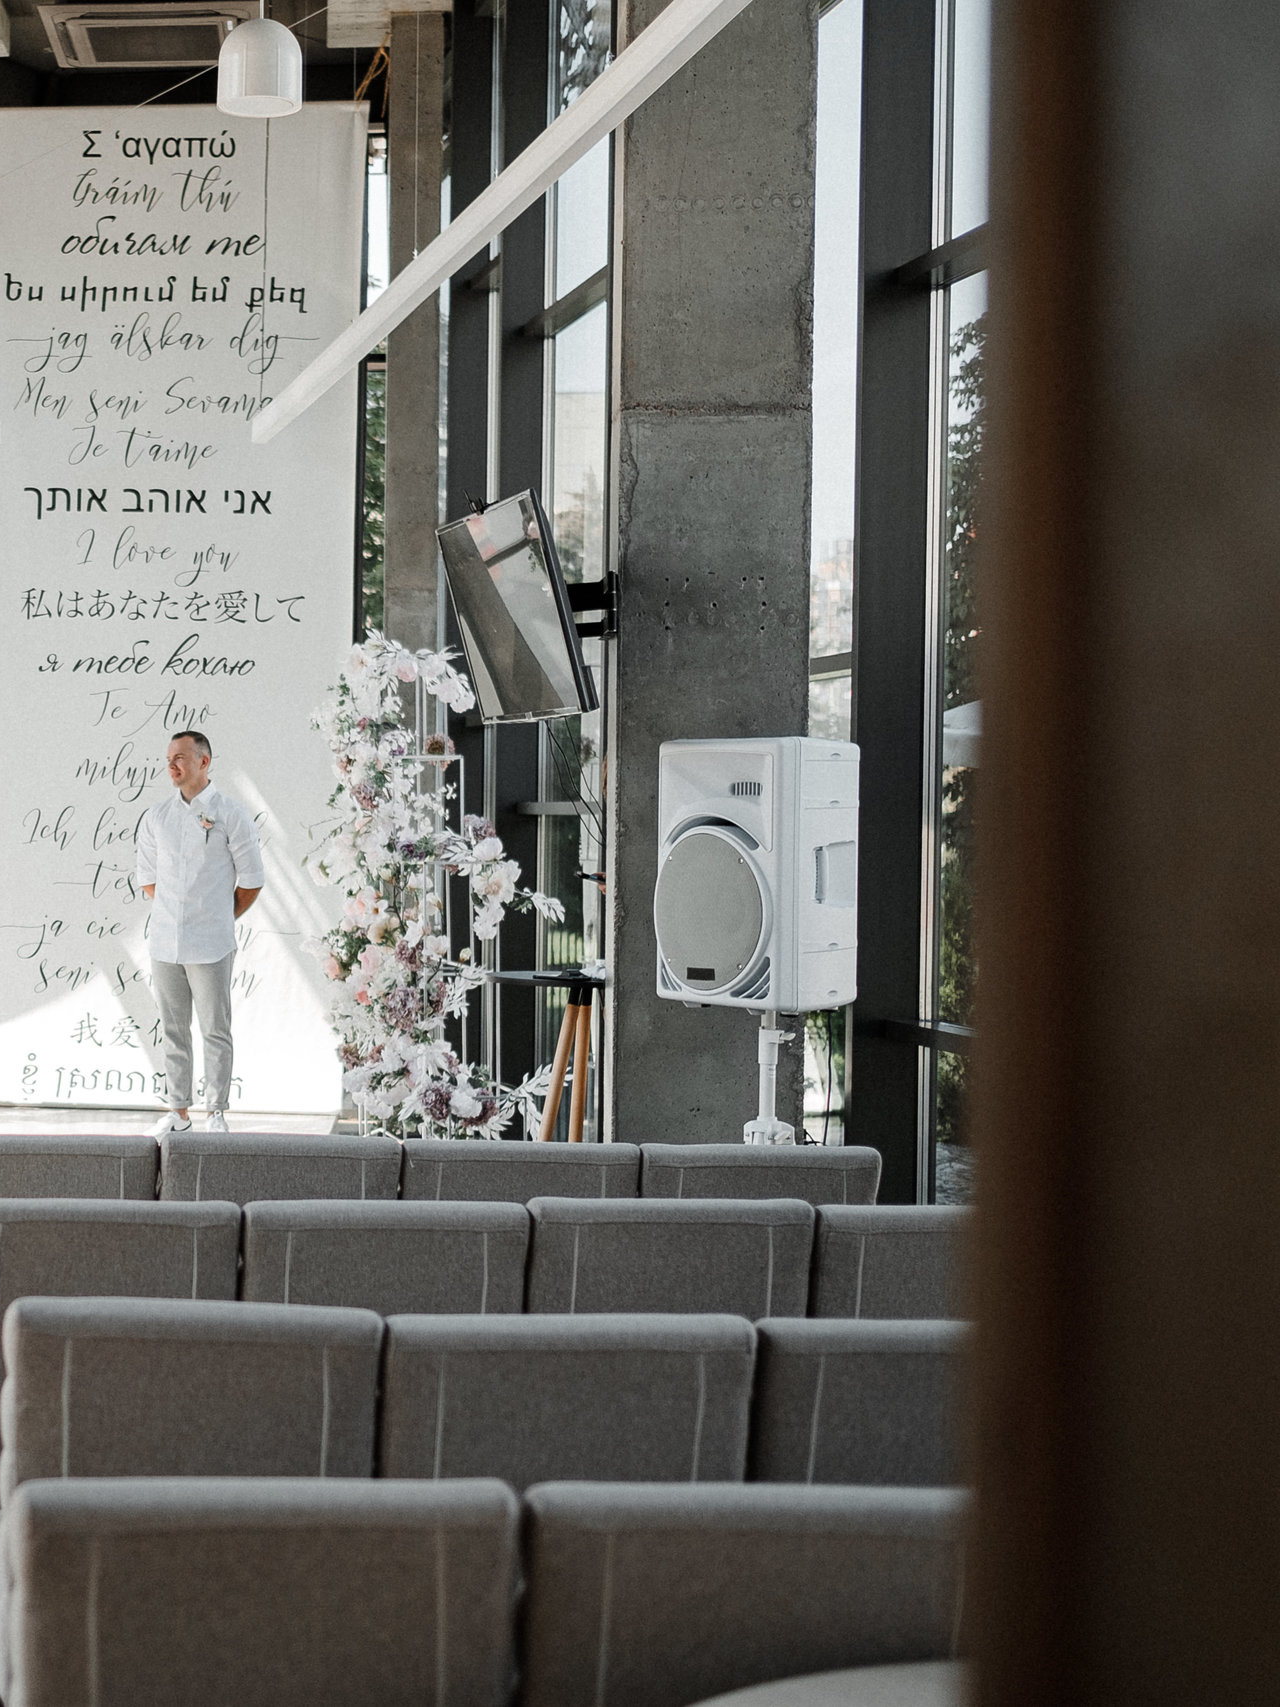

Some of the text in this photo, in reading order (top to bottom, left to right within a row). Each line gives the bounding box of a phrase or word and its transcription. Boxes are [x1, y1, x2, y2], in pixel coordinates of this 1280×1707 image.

[205, 233, 264, 257] те
[6, 312, 320, 374] jag älskar dig
[13, 376, 73, 419] Men
[85, 390, 148, 422] seni
[68, 425, 109, 465] Je
[24, 487, 272, 520] אני אוהב אותך
[76, 526, 240, 587] I love you
[21, 587, 306, 624] 私はあなたを愛して
[38, 633, 256, 677] я тебе кохаю
[90, 688, 218, 737] Te Amo
[75, 741, 165, 802] miluji
[22, 806, 77, 851] Ich
[0, 914, 70, 959] ja
[34, 958, 96, 993] seni
